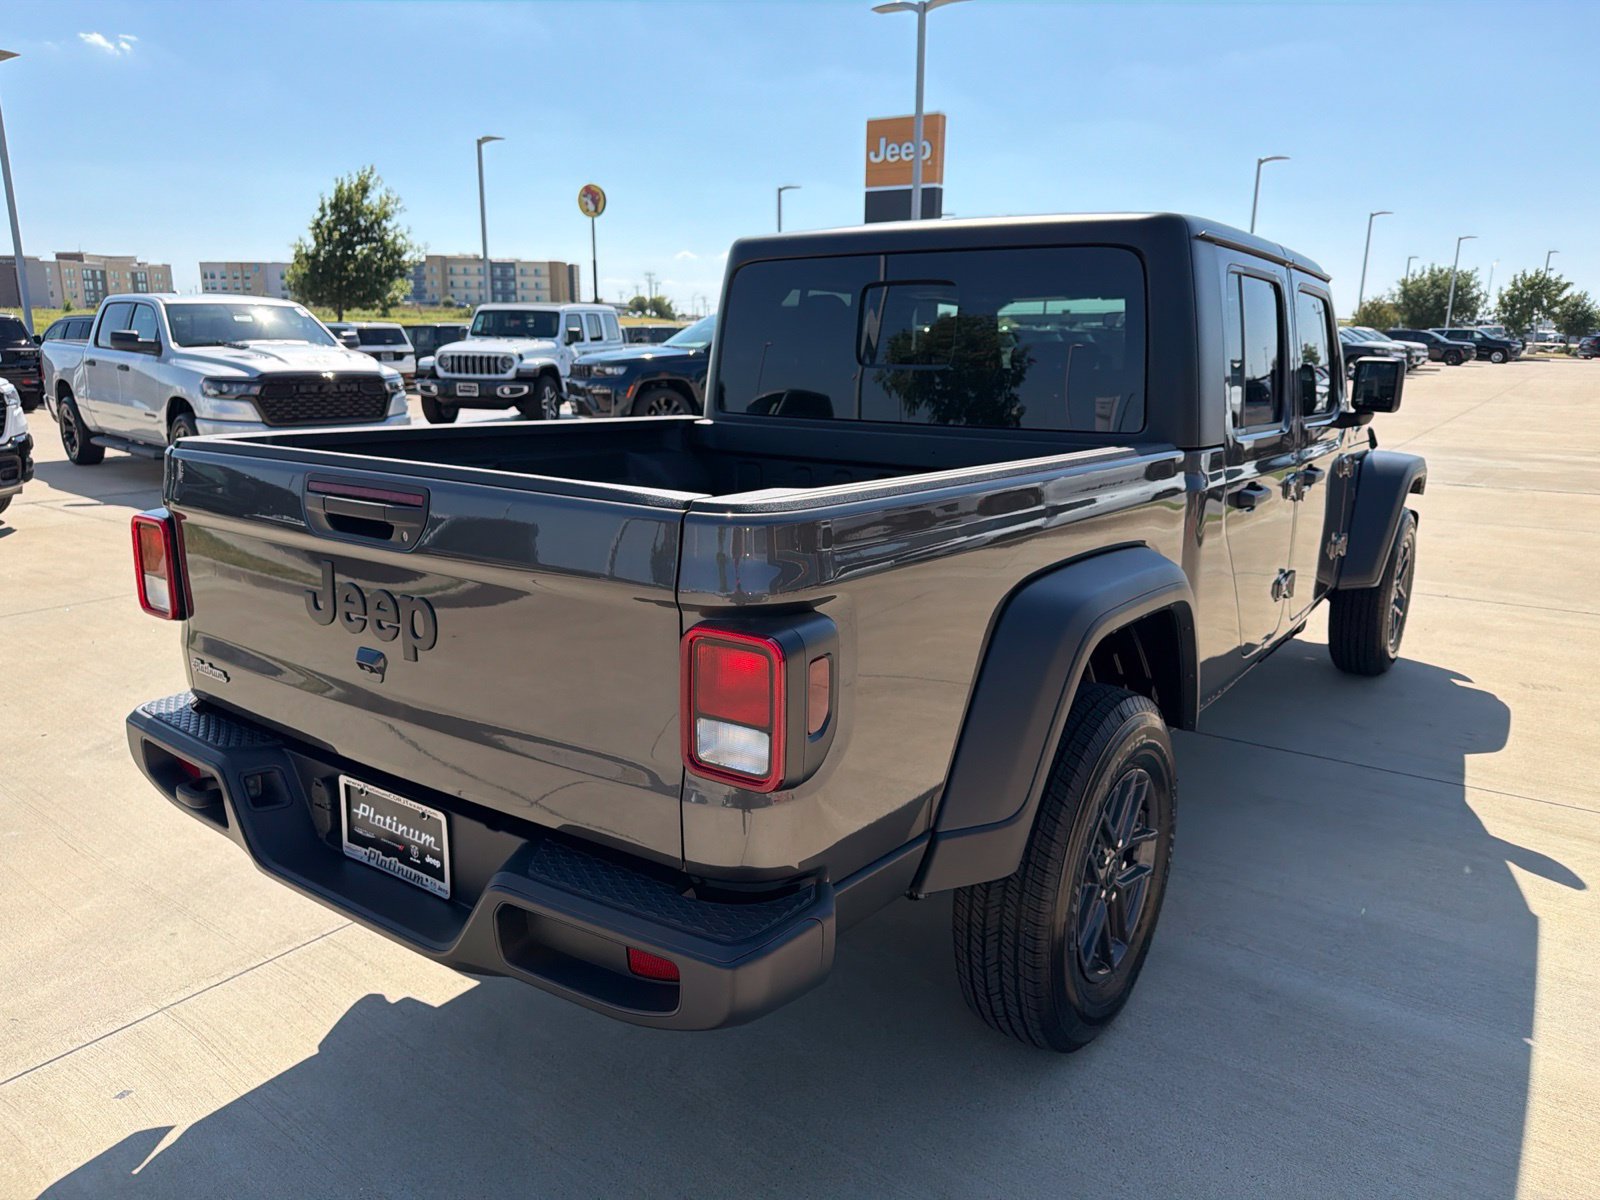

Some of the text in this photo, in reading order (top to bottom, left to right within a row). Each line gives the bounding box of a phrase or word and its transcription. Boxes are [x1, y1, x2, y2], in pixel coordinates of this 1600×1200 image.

[304, 560, 438, 662] Jeep
[353, 803, 441, 851] Platinum
[367, 848, 429, 888] Platinum
[425, 854, 441, 869] Jeep
